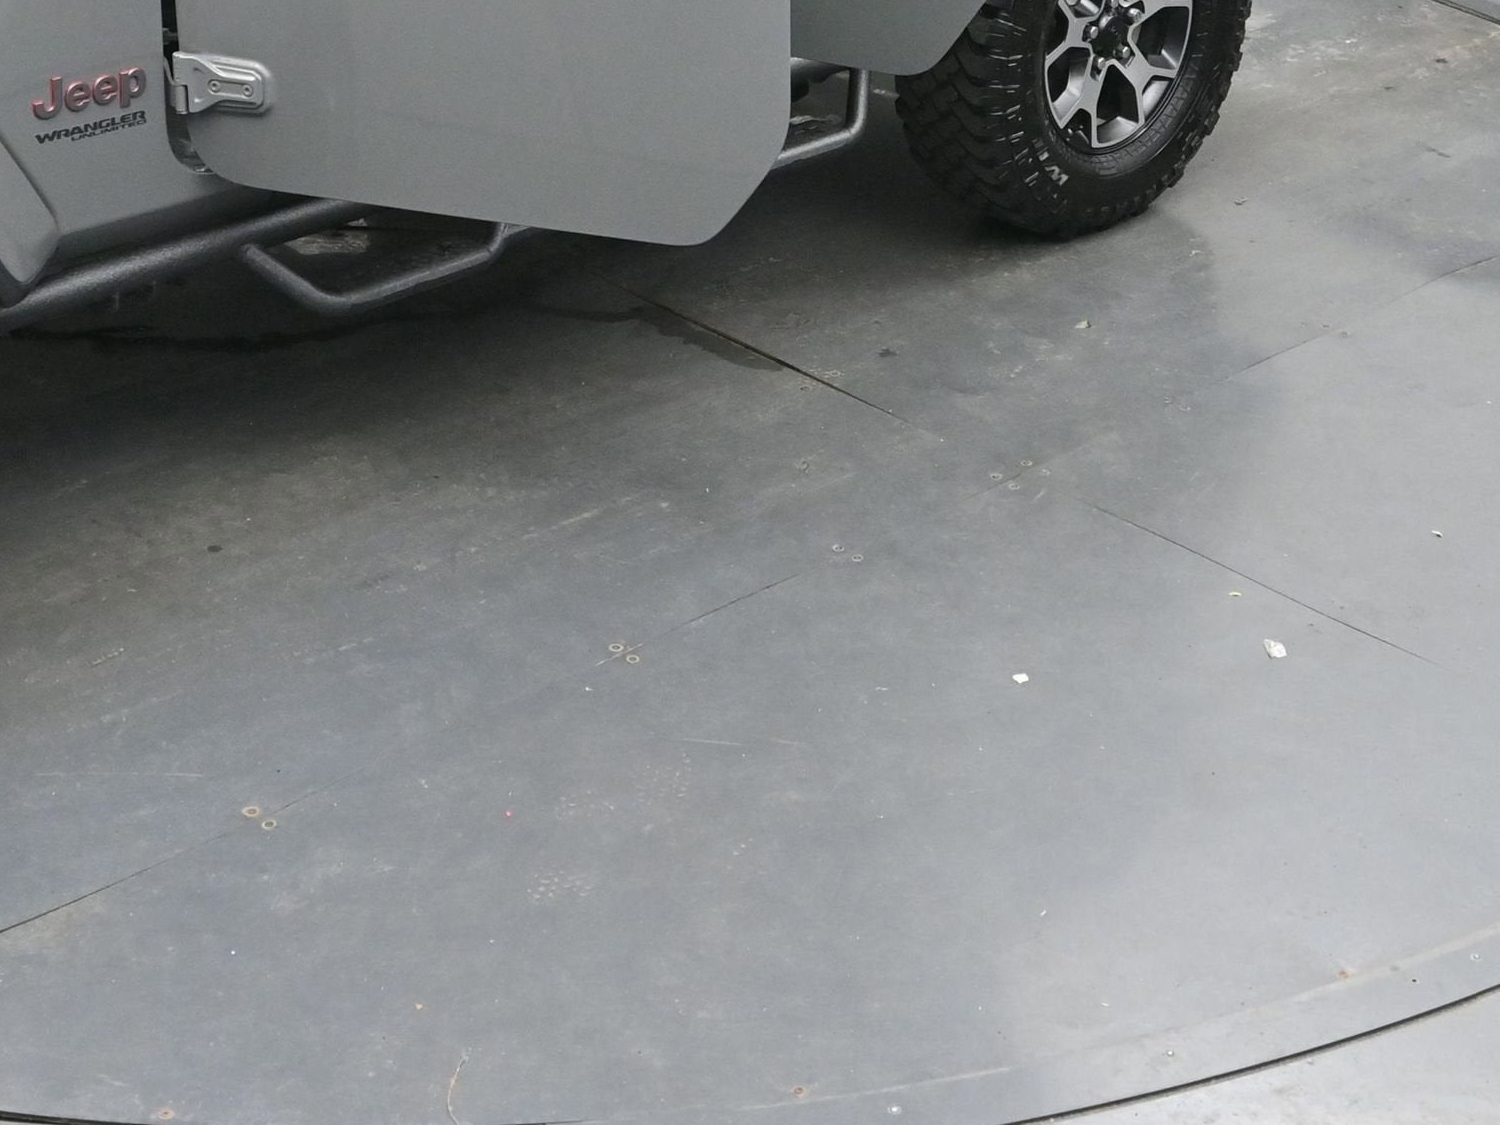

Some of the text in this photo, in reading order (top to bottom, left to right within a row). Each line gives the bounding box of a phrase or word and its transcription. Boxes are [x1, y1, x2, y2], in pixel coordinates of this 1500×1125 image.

[31, 67, 147, 120] Jeep
[35, 110, 146, 144] WRANGLER
[71, 118, 147, 142] UNLIMITED
